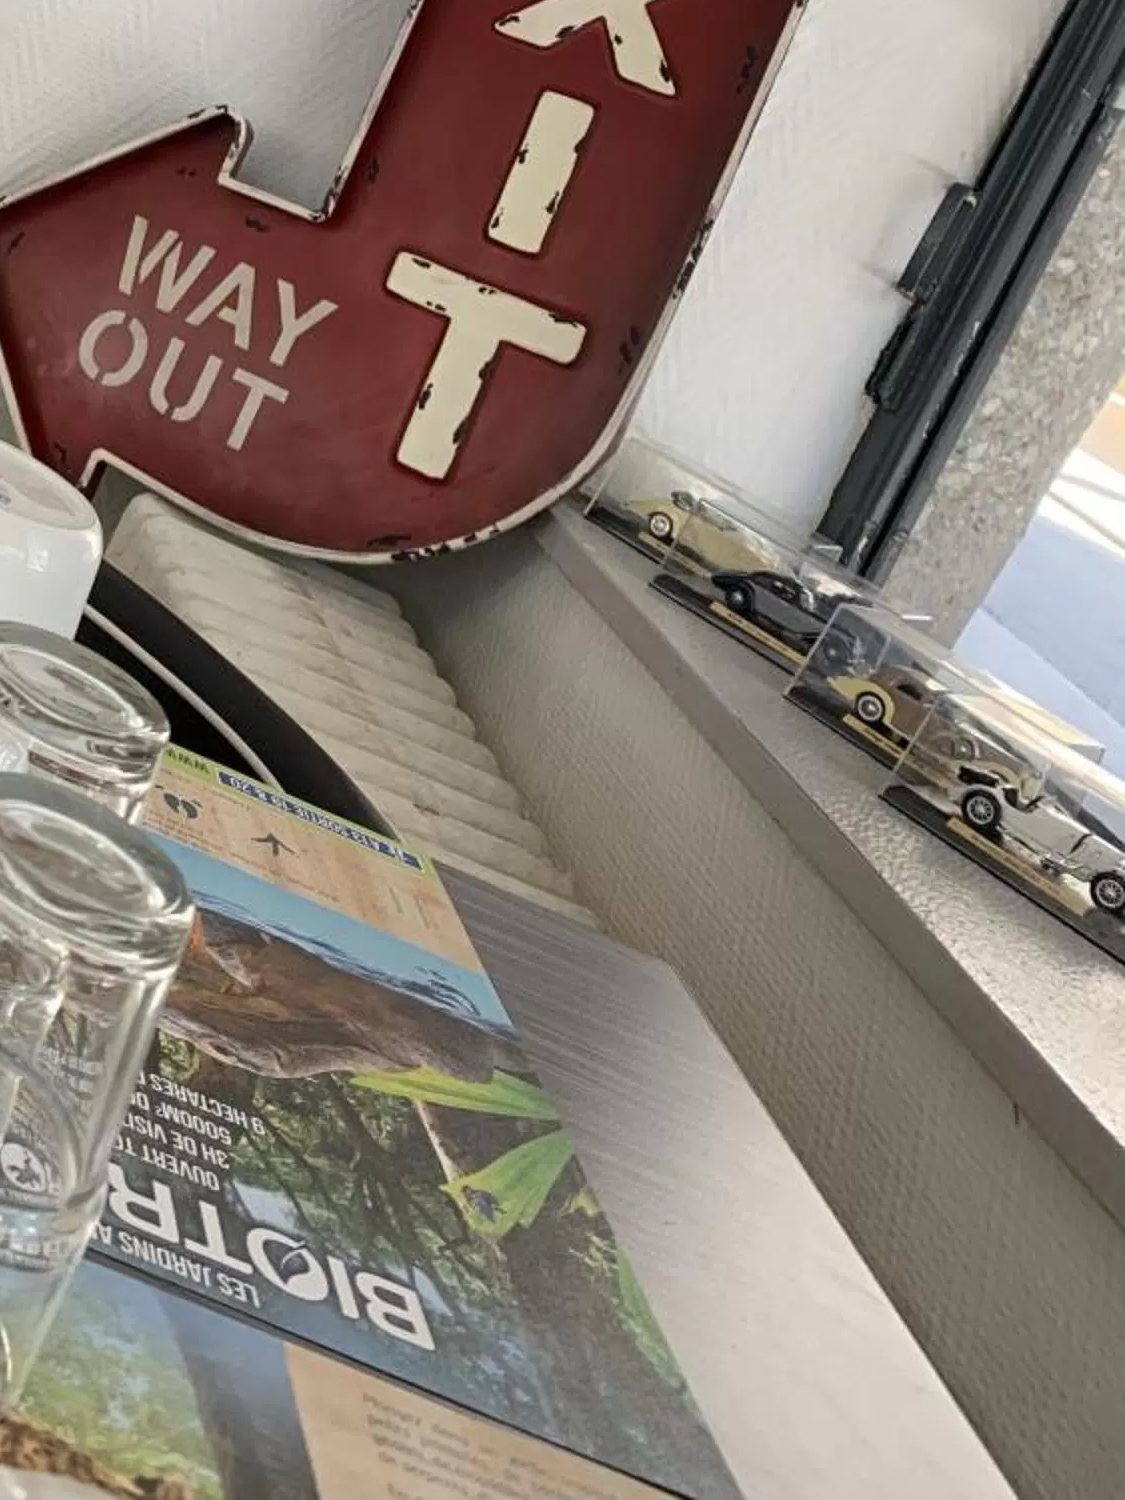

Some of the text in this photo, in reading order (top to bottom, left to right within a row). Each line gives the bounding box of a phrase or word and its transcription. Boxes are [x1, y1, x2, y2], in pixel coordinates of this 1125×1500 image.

[117, 214, 337, 367] WAY
[77, 309, 289, 451] OUT
[150, 1074, 265, 1135] 9 HECTARES
[142, 1145, 219, 1190] OUVERT
[171, 1130, 197, 1155] DE
[201, 1143, 229, 1169] 3H
[121, 1232, 211, 1287] JARDINS
[217, 1273, 260, 1308] LES
